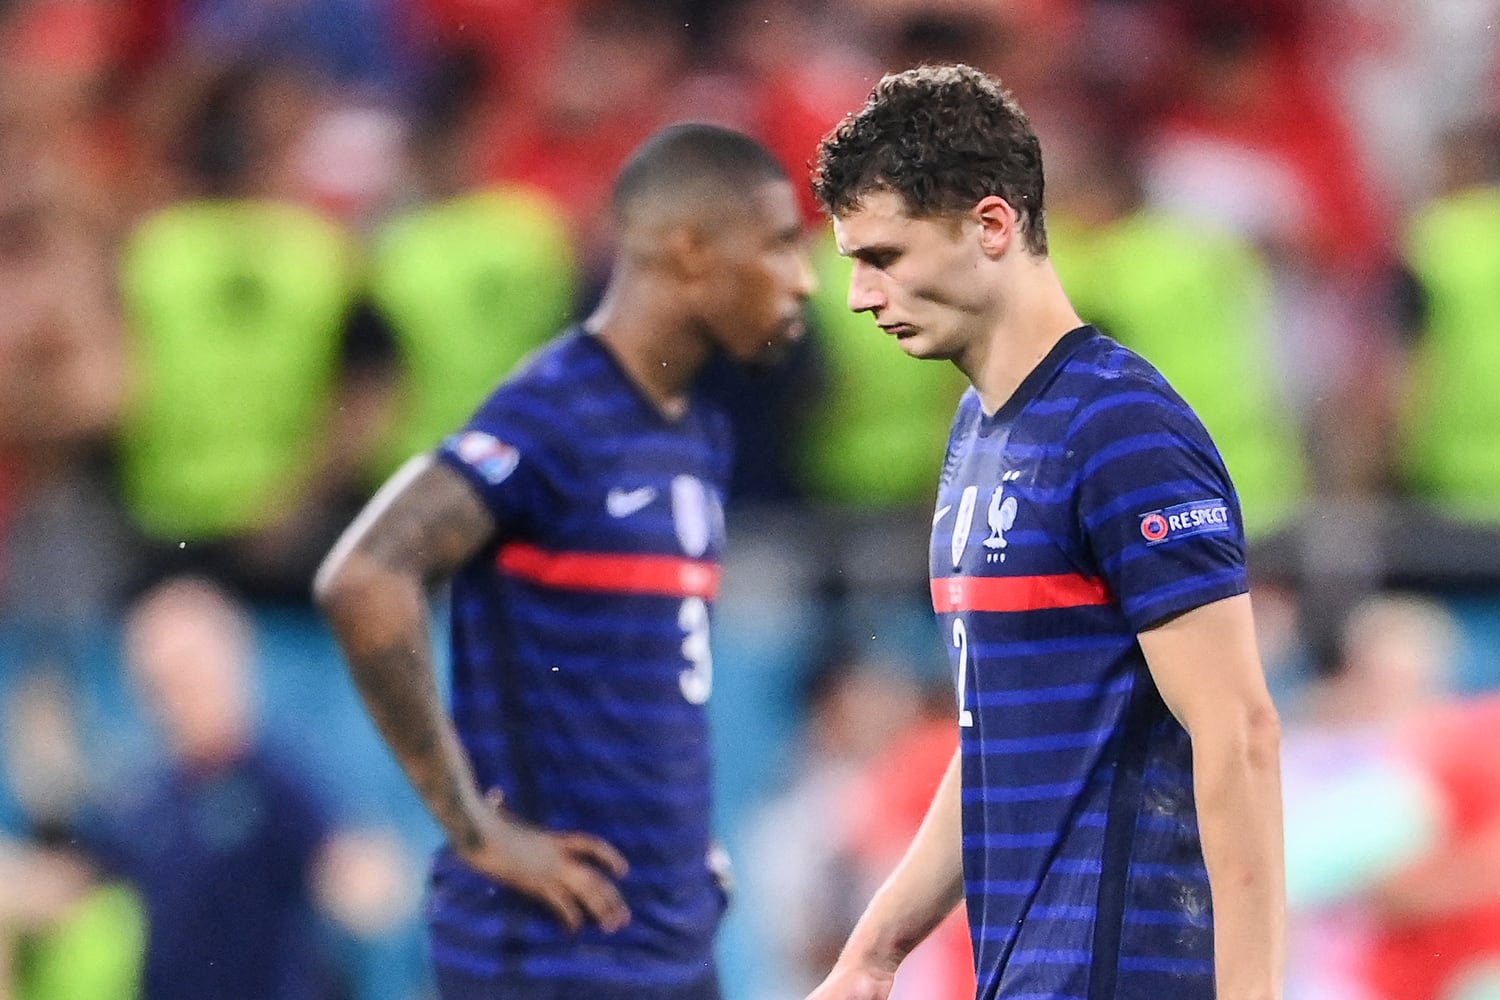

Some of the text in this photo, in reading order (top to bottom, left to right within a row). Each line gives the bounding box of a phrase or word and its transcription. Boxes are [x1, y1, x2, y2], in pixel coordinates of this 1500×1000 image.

[1168, 506, 1228, 532] RESPECT
[677, 596, 712, 704] 3
[952, 617, 974, 728] 2
